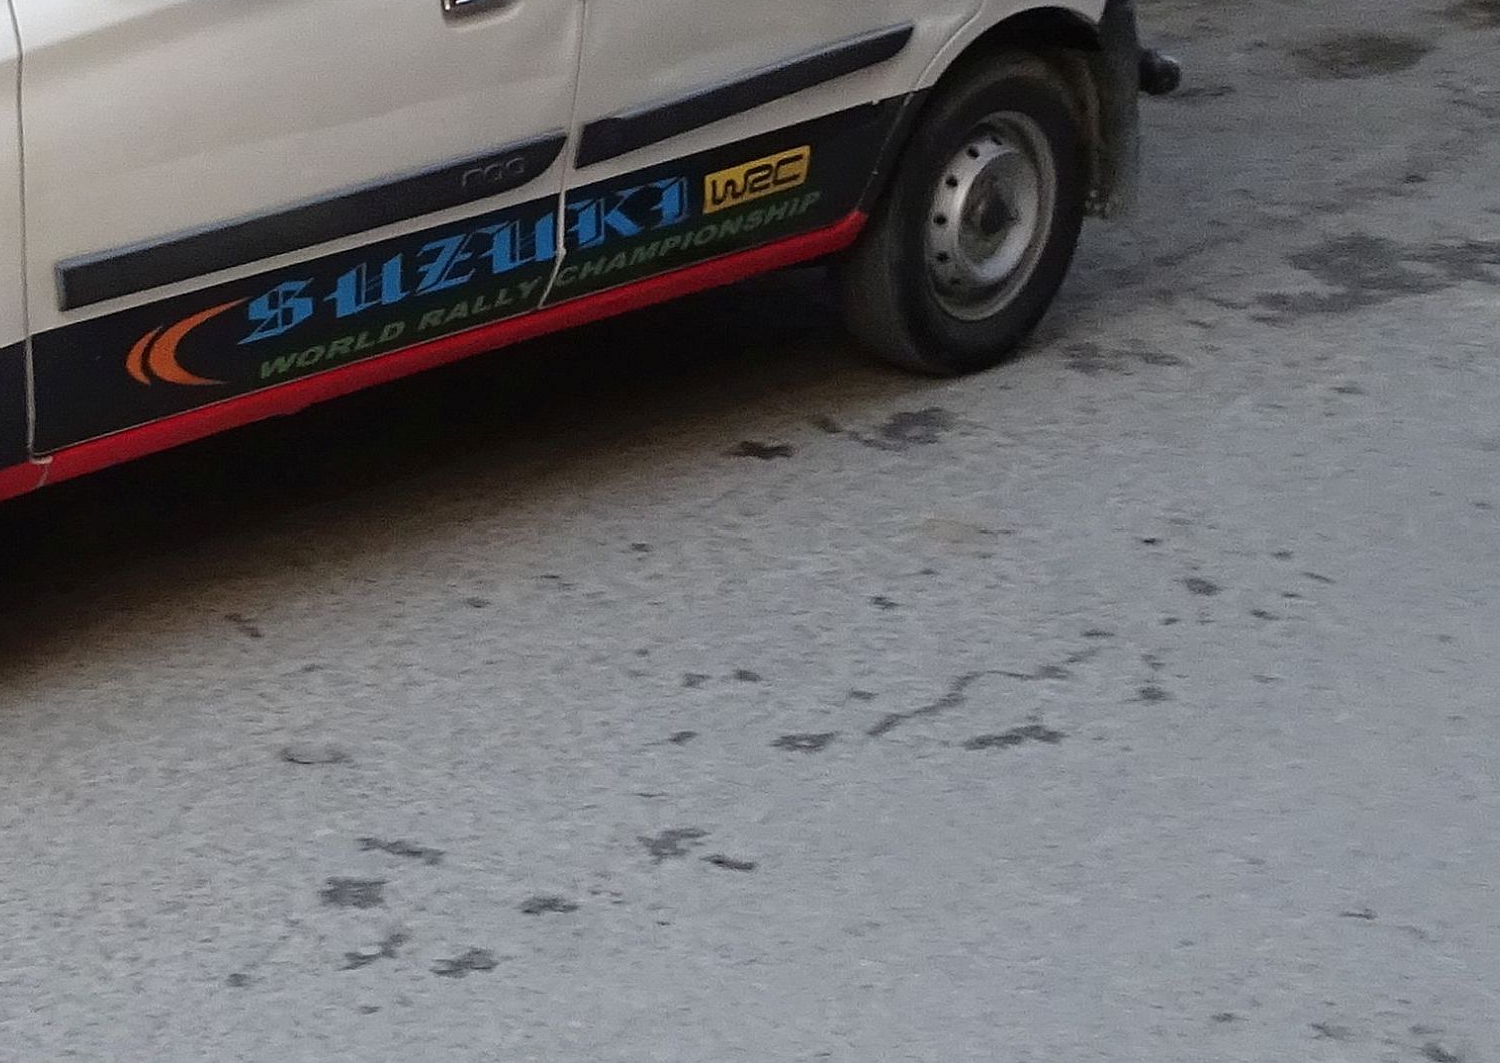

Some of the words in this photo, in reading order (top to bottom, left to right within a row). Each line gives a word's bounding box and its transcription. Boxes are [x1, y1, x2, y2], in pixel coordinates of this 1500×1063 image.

[237, 176, 691, 345] SUZUKI
[711, 154, 804, 206] WRC
[260, 320, 406, 380] WORLD
[417, 275, 543, 331] RALLY
[552, 190, 821, 287] CHAMPIONSHIP
